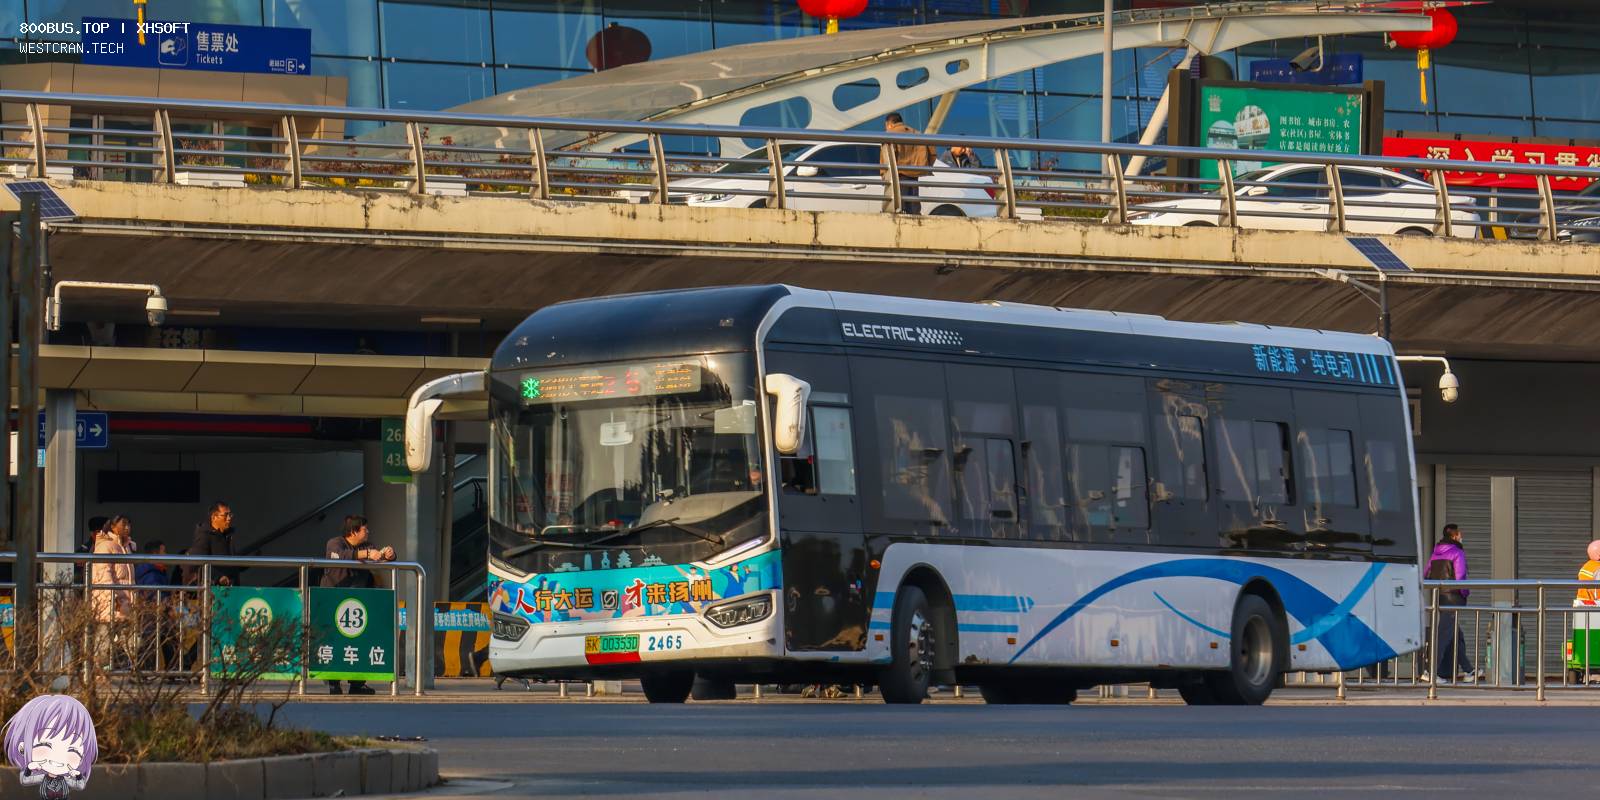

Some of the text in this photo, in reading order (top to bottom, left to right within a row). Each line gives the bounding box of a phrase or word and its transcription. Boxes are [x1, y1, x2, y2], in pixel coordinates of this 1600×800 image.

[196, 31, 239, 53] 售票处
[196, 53, 224, 65] Tickets
[842, 322, 916, 342] ELECTRIC
[386, 427, 403, 442] 26
[514, 578, 713, 614] 人行大运 才来扬州
[244, 607, 269, 628] 26
[339, 607, 364, 629] 43
[648, 634, 682, 651] 2465
[318, 645, 386, 667] 停车位
